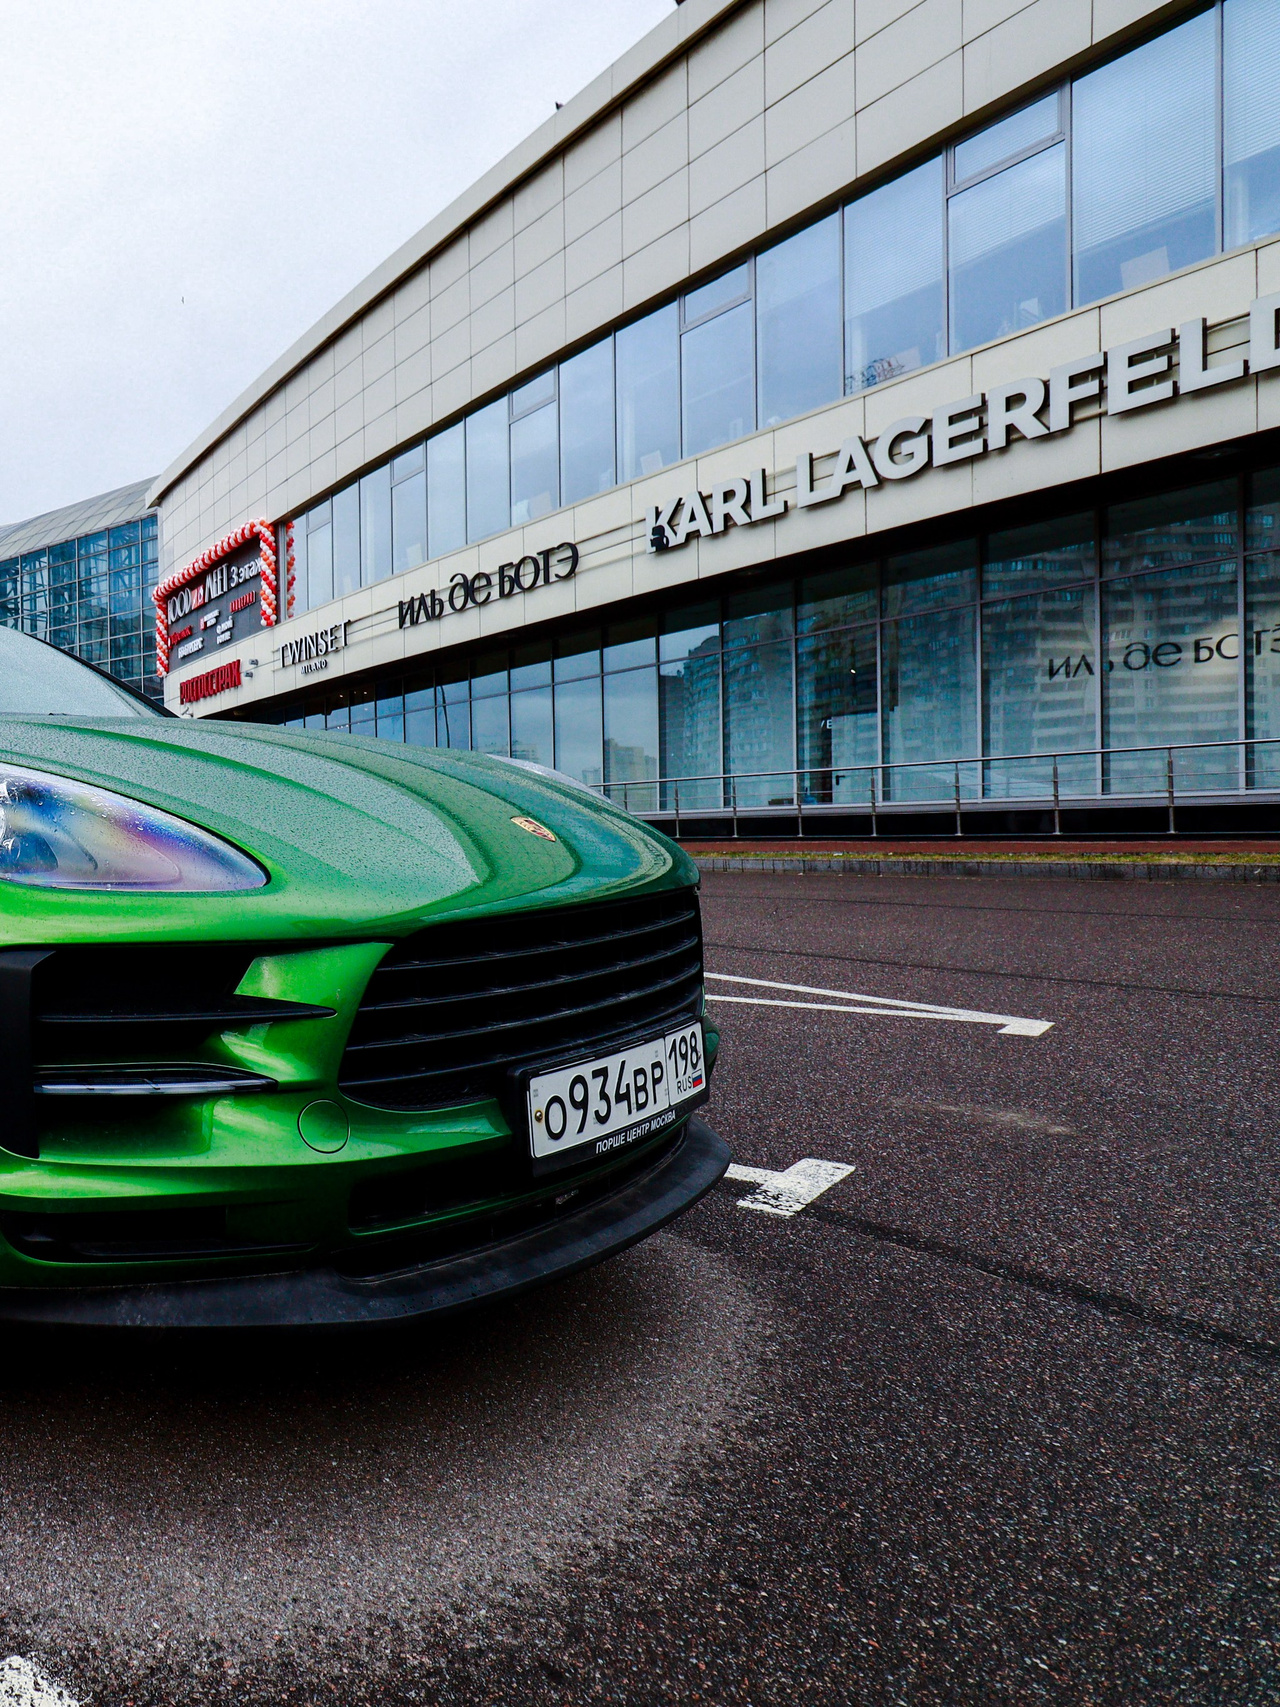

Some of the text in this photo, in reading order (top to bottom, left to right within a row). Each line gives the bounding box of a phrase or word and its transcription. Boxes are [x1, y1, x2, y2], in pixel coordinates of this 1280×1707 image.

[645, 468, 788, 554] KARL
[398, 589, 444, 629] ИЛЬ
[498, 542, 579, 599] БОТЭ
[280, 619, 351, 668] TWINSET
[301, 659, 328, 674] MILANO
[668, 1030, 699, 1080] 198
[677, 1076, 693, 1095] RUS
[595, 1109, 677, 1154] ПОРШЕ ЦЕНТР МОСКВА
